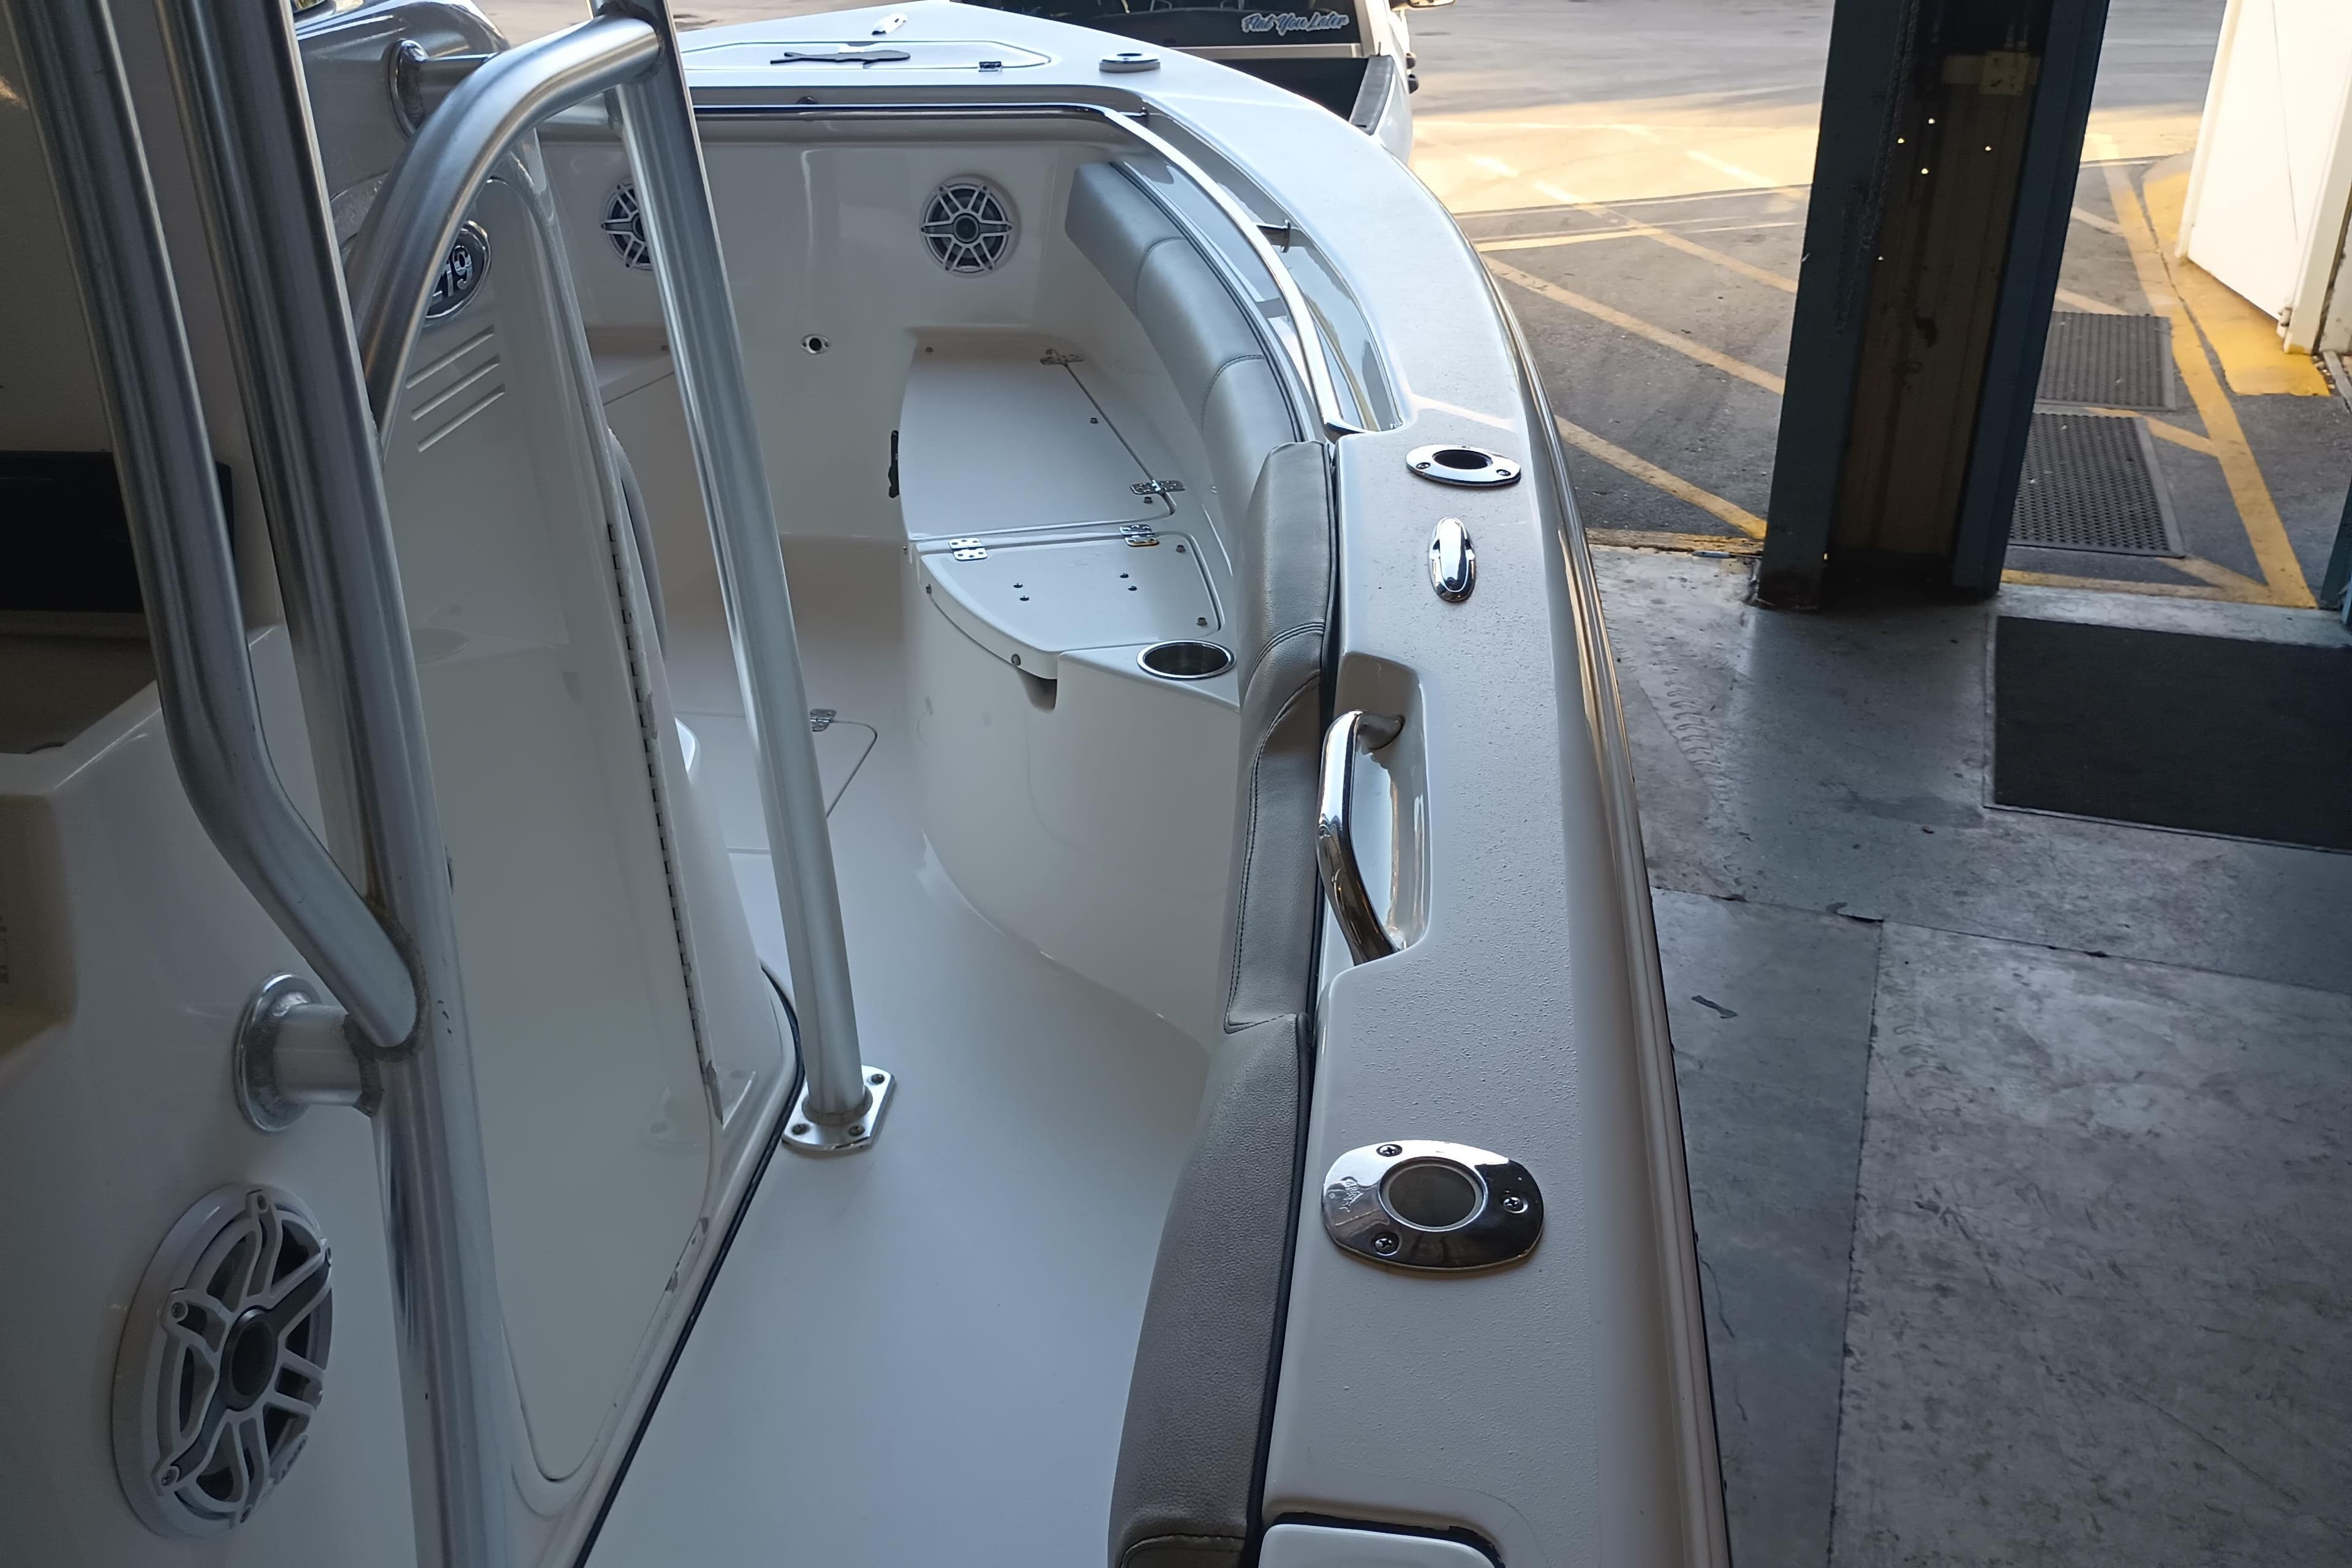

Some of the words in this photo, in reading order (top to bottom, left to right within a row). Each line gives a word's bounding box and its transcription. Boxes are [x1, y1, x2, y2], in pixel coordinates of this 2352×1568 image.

[1276, 13, 1307, 34] You
[1307, 12, 1348, 30] Later
[432, 245, 473, 304] 19
